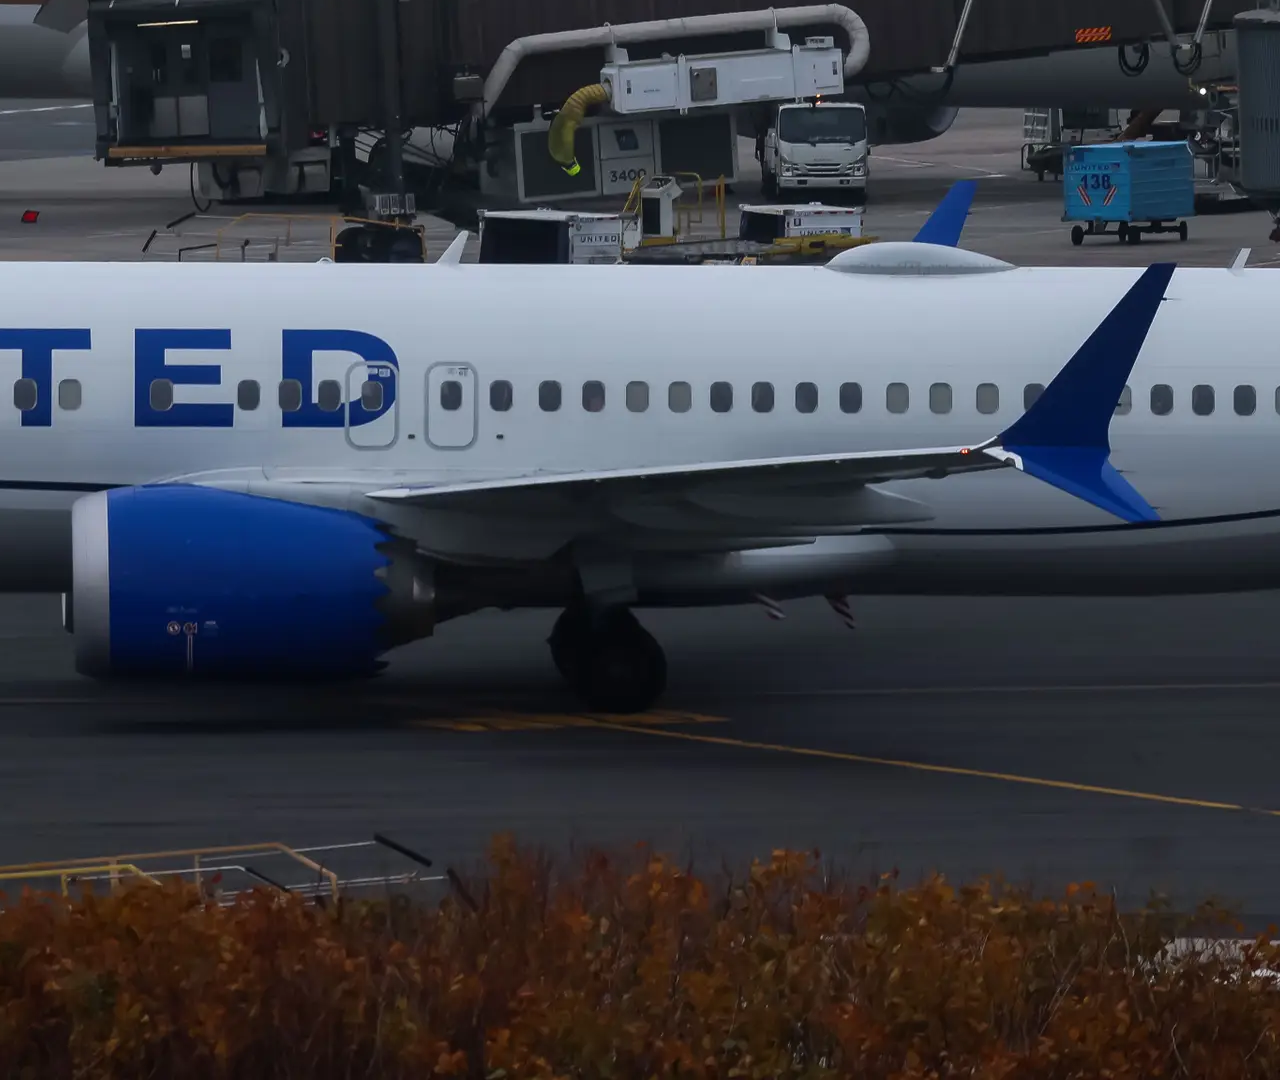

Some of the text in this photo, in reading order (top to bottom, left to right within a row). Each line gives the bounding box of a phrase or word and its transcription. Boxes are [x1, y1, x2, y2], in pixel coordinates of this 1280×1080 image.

[1078, 164, 1110, 172] UNITED
[1079, 173, 1113, 192] 138
[580, 234, 617, 244] UNITED
